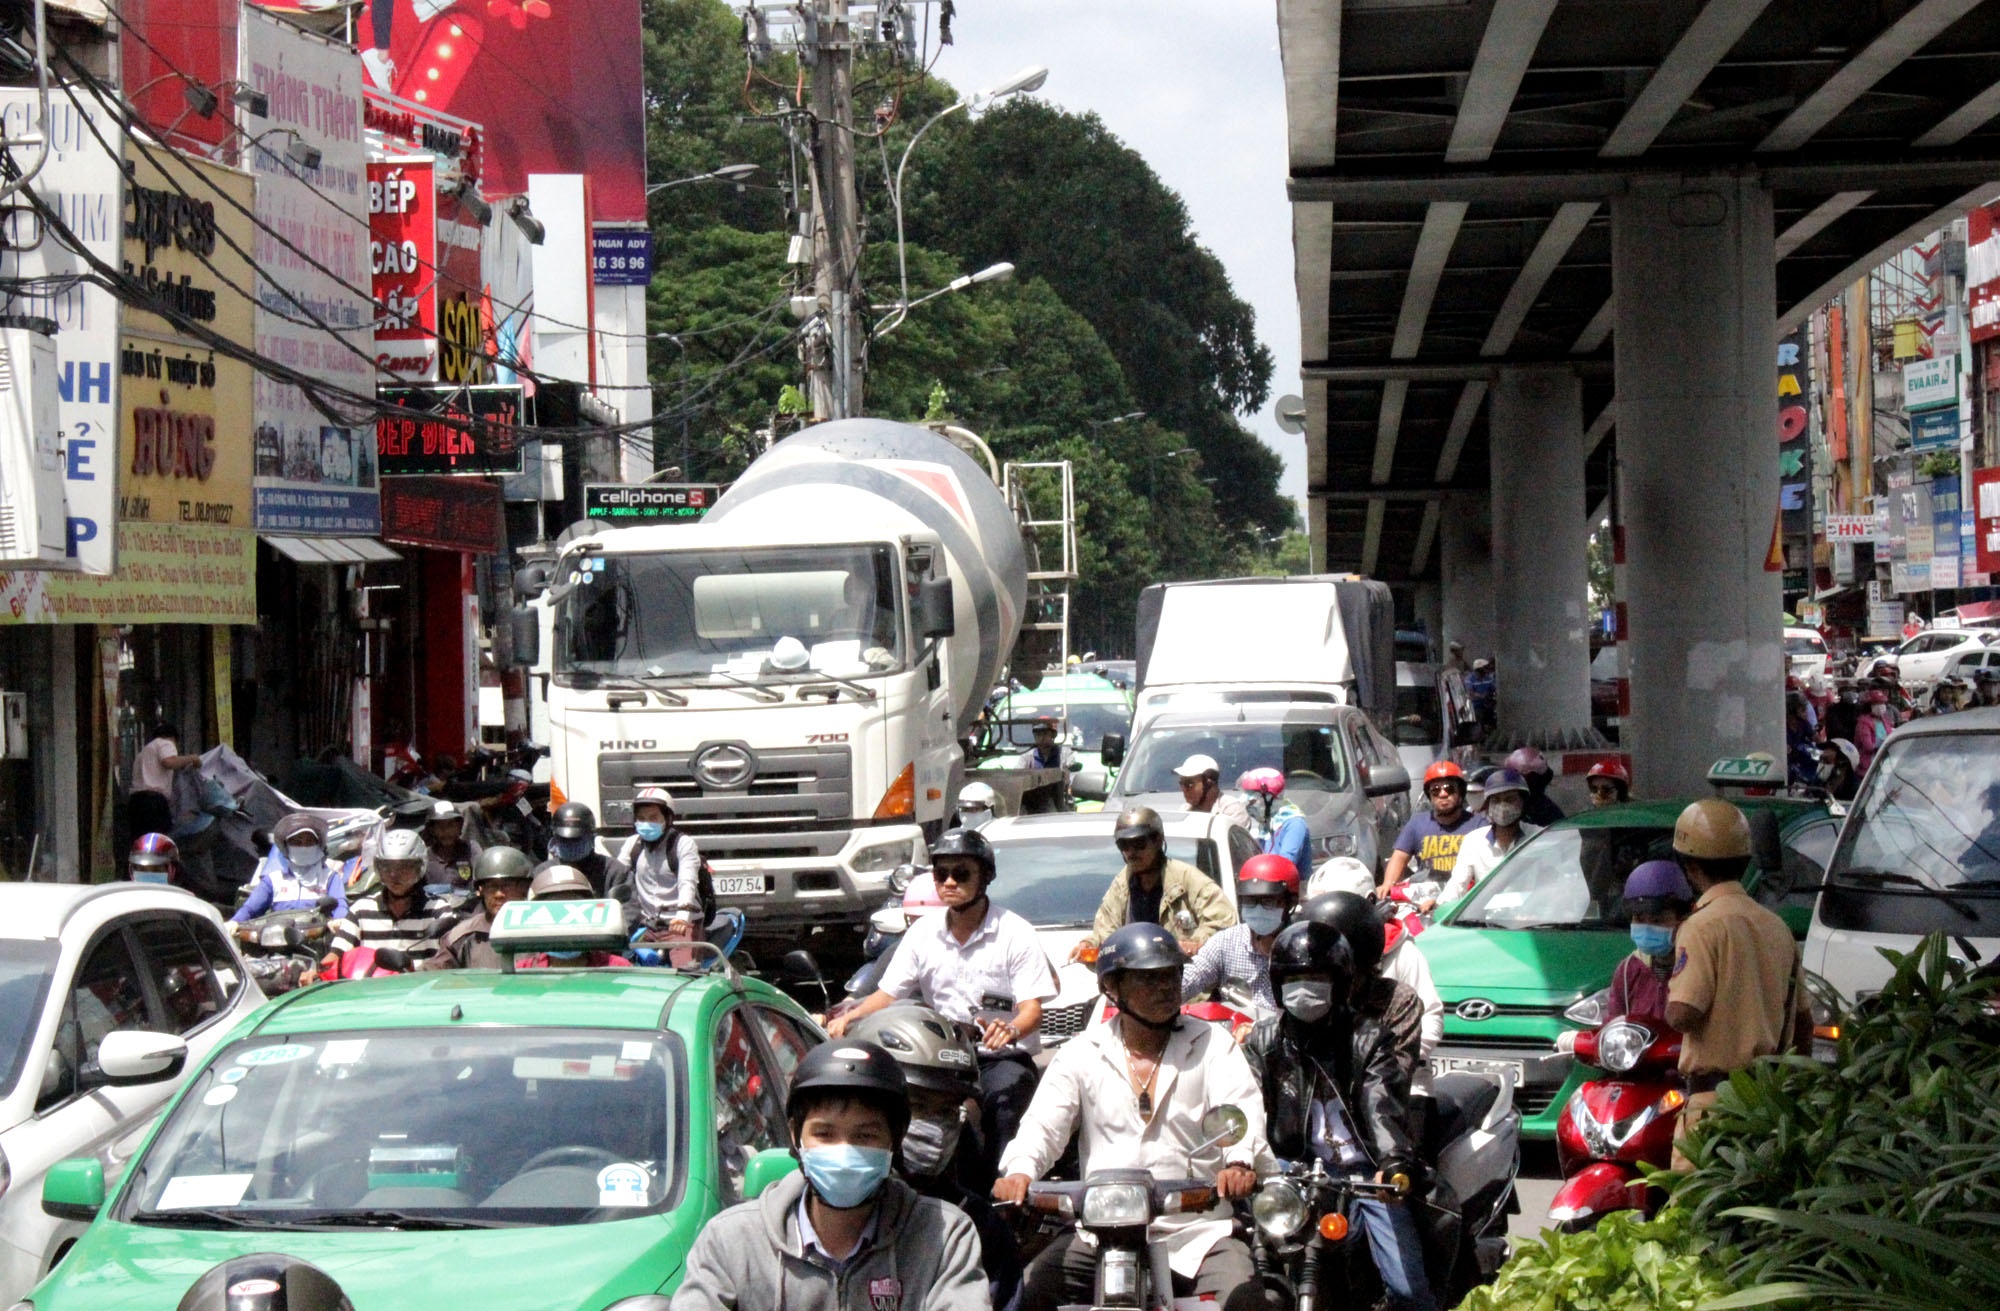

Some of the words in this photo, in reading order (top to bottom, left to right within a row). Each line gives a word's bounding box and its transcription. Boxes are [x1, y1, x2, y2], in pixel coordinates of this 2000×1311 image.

[368, 168, 416, 213] BẾP
[598, 239, 623, 248] NGAN
[627, 239, 646, 248] ADV
[371, 240, 417, 274] CAO
[610, 256, 626, 269] 36
[629, 256, 645, 269] 96
[600, 489, 686, 506] cellphone
[1838, 523, 1864, 536] HN
[600, 739, 657, 750] HINO
[805, 733, 849, 743] 700
